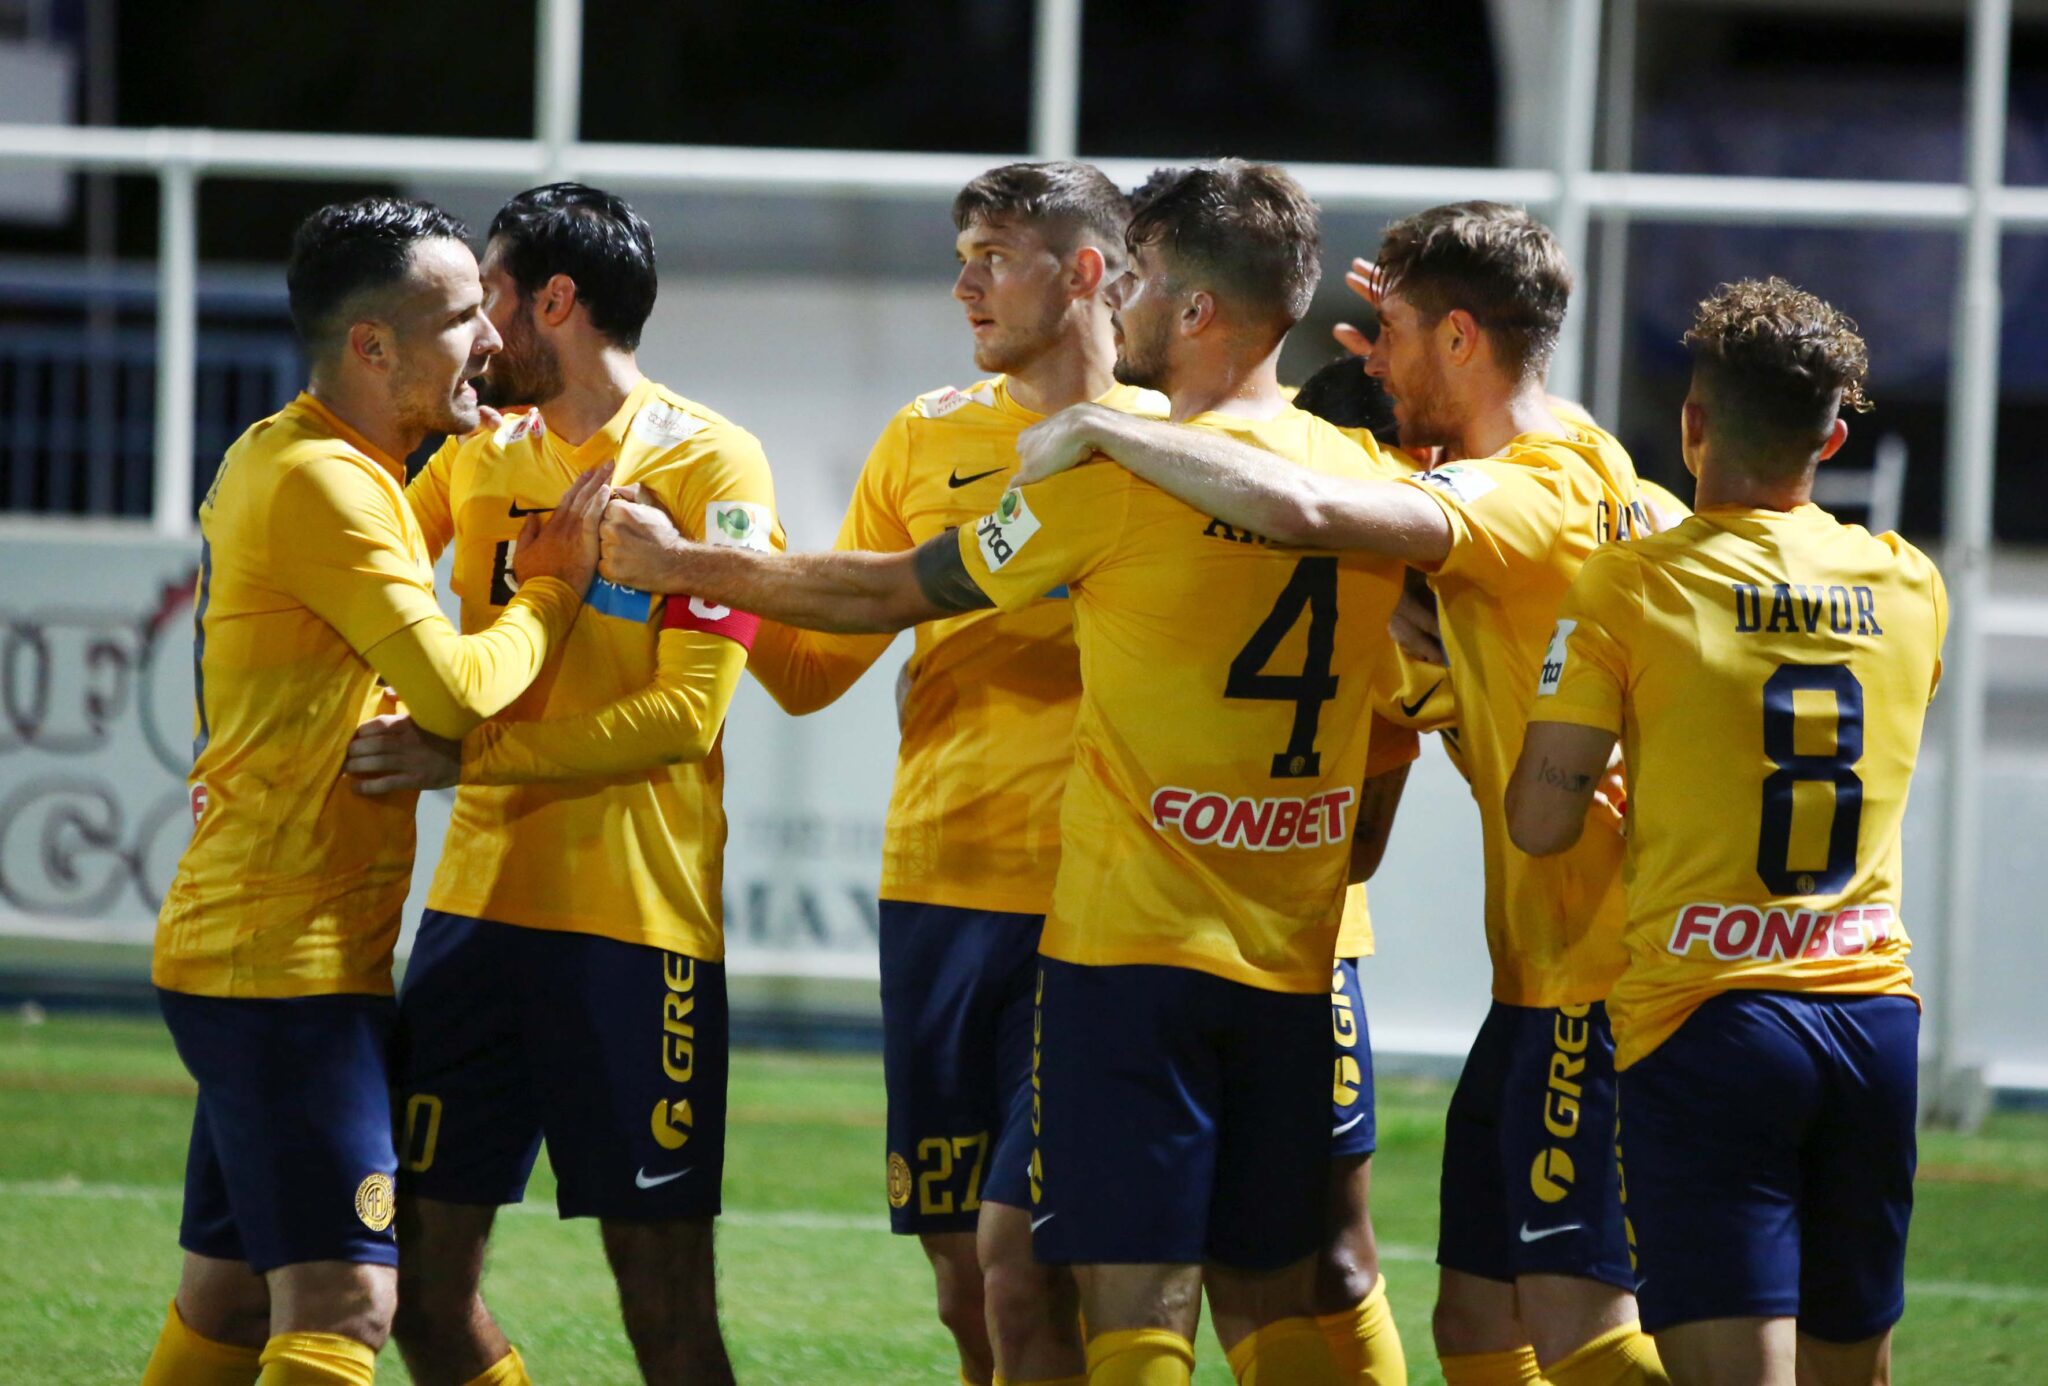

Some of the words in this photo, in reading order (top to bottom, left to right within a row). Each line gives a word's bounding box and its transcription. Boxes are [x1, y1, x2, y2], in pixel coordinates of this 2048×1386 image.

[1732, 584, 1883, 635] DAVOR
[1223, 556, 1339, 778] 4
[1756, 664, 1864, 895] 8
[1153, 788, 1353, 851] FONBET
[1669, 903, 1895, 960] FONBET
[918, 1131, 988, 1214] 27
